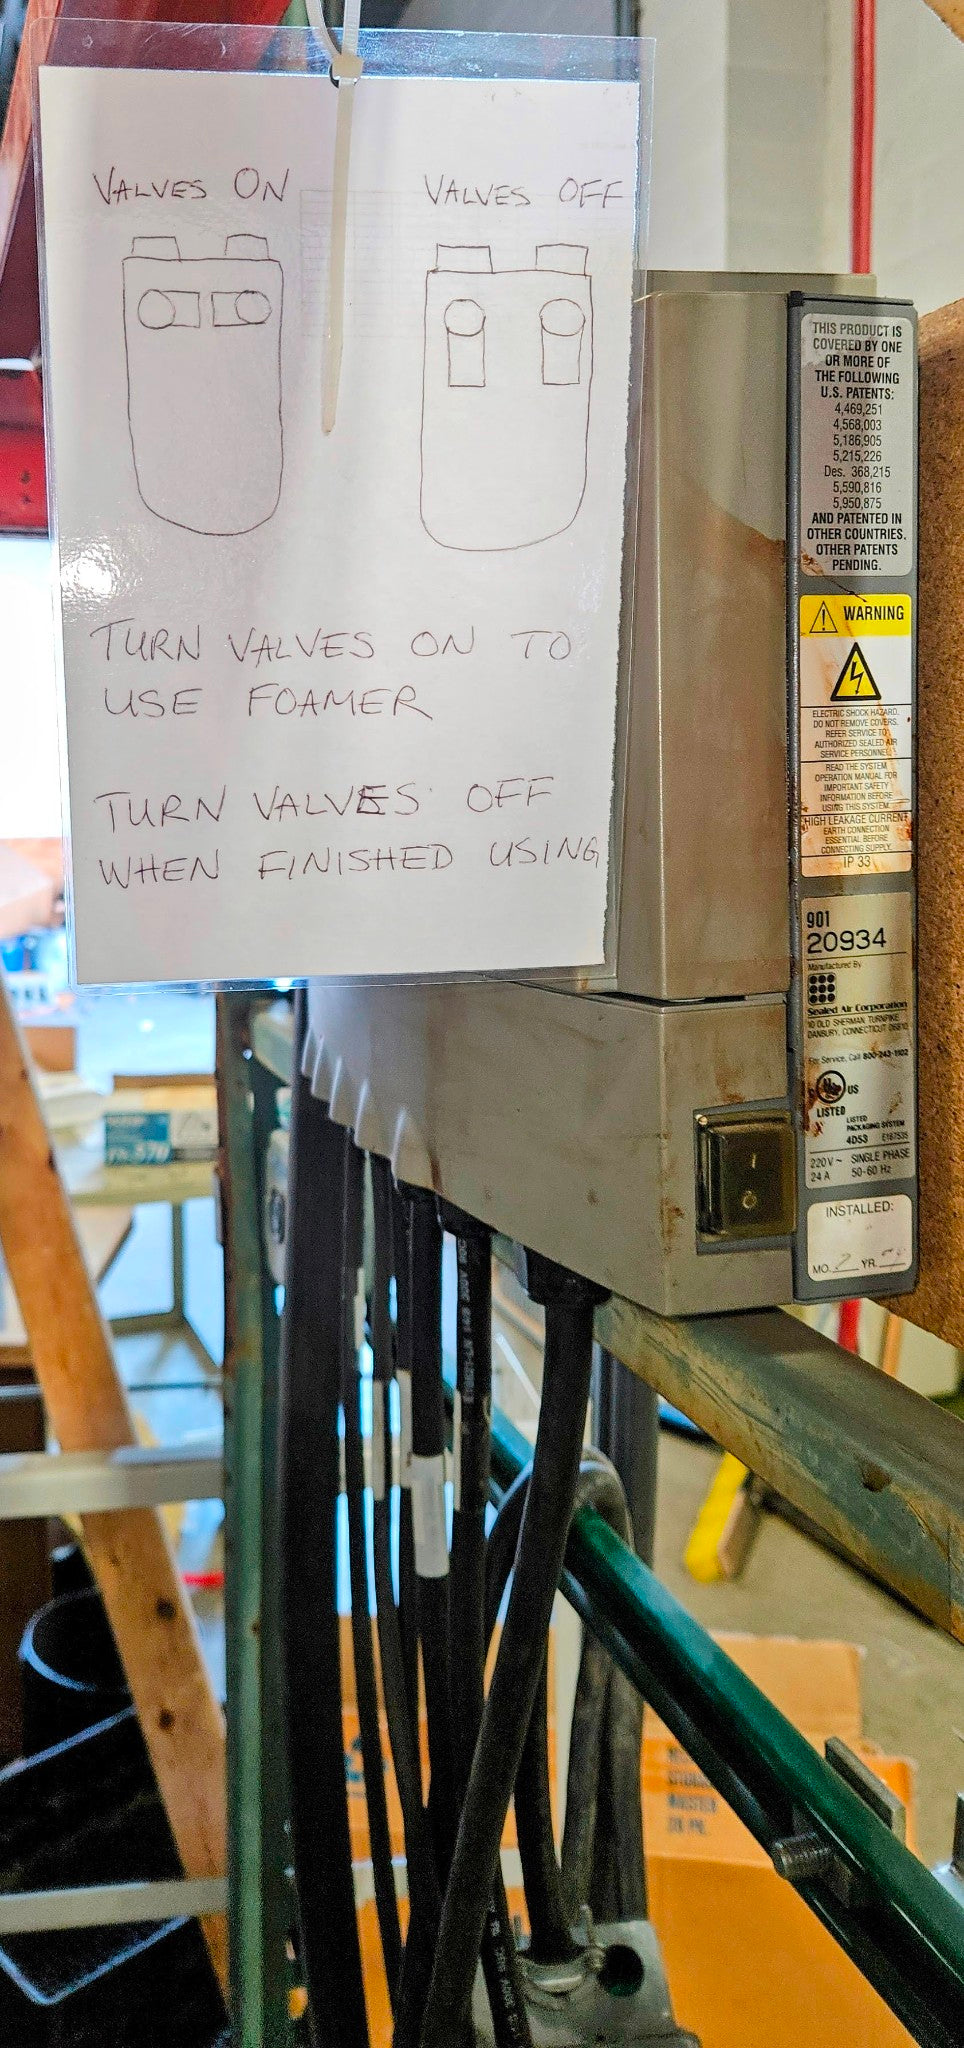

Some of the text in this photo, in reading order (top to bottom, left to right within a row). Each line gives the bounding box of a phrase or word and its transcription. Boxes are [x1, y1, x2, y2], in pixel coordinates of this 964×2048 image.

[93, 166, 290, 205] VALVES ON
[425, 174, 626, 208] VALVES OFF
[813, 322, 902, 338] THIS PRODUCT IS
[813, 338, 903, 353] COVERED BY ONE
[825, 354, 891, 368] OR MORE OF
[815, 370, 900, 384] THE FOLLOWING
[821, 386, 894, 400] U.S. PATENTS:
[835, 403, 882, 417] 4,469,251
[833, 419, 882, 432] 4,568,003
[833, 434, 882, 448] 5,186,905
[833, 450, 882, 463] 5,215,226
[824, 465, 891, 479] Des. 368,215
[833, 481, 882, 495] 5,590,816
[833, 497, 882, 510] 5,950,875
[812, 513, 902, 524] AND PATENTED IN
[807, 528, 906, 540] OTHER COUNTRIES.
[816, 544, 898, 555] OTHER PATENTS
[832, 559, 882, 571] PENDING.
[843, 605, 904, 621] WARNING
[91, 618, 572, 667] TURN VALVES ON TO
[104, 684, 434, 722] USE FOAMER
[812, 709, 845, 718] ELECTRIC
[846, 708, 869, 717] SHOCK
[813, 720, 823, 728] DO
[825, 720, 839, 728] NOT
[840, 719, 869, 727] REMOVE
[826, 729, 846, 738] REFER
[848, 729, 877, 737] SERVICE
[814, 738, 898, 748] AUTHORIZED SEALED AIR
[820, 750, 848, 758] SERVICE
[826, 763, 843, 772] READ
[845, 763, 859, 771] THE
[815, 771, 898, 782] OPERATION MANUAL FOR
[824, 782, 889, 791] IMPORTANT SAFETY
[820, 792, 893, 802] INFORMATION BEFORE
[95, 776, 554, 834] TURN VALVES OFF
[822, 803, 843, 812] USING
[845, 803, 860, 811] THIS
[804, 813, 908, 826] HIGH LEAKAGE CURRENT
[823, 825, 890, 835] EARTH CONNECTION
[825, 834, 888, 844] ESSENTIAL BEFORE
[821, 845, 865, 854] CONNECTING
[100, 835, 600, 889] WHEN FINISHED USING
[843, 855, 871, 868] IP 33
[807, 911, 829, 928] 901
[807, 928, 887, 954] 20934
[807, 1000, 908, 1016] Sealed Air Corporation
[847, 1084, 859, 1094] US
[816, 1106, 846, 1118] LISTED
[846, 1115, 868, 1123] LISTED
[851, 1151, 880, 1164] SINGLE
[883, 1148, 911, 1160] PHASE
[811, 1171, 822, 1182] 24
[851, 1166, 878, 1178] 50-60
[880, 1164, 892, 1174] Hz
[826, 1200, 894, 1218] INSTALLED:
